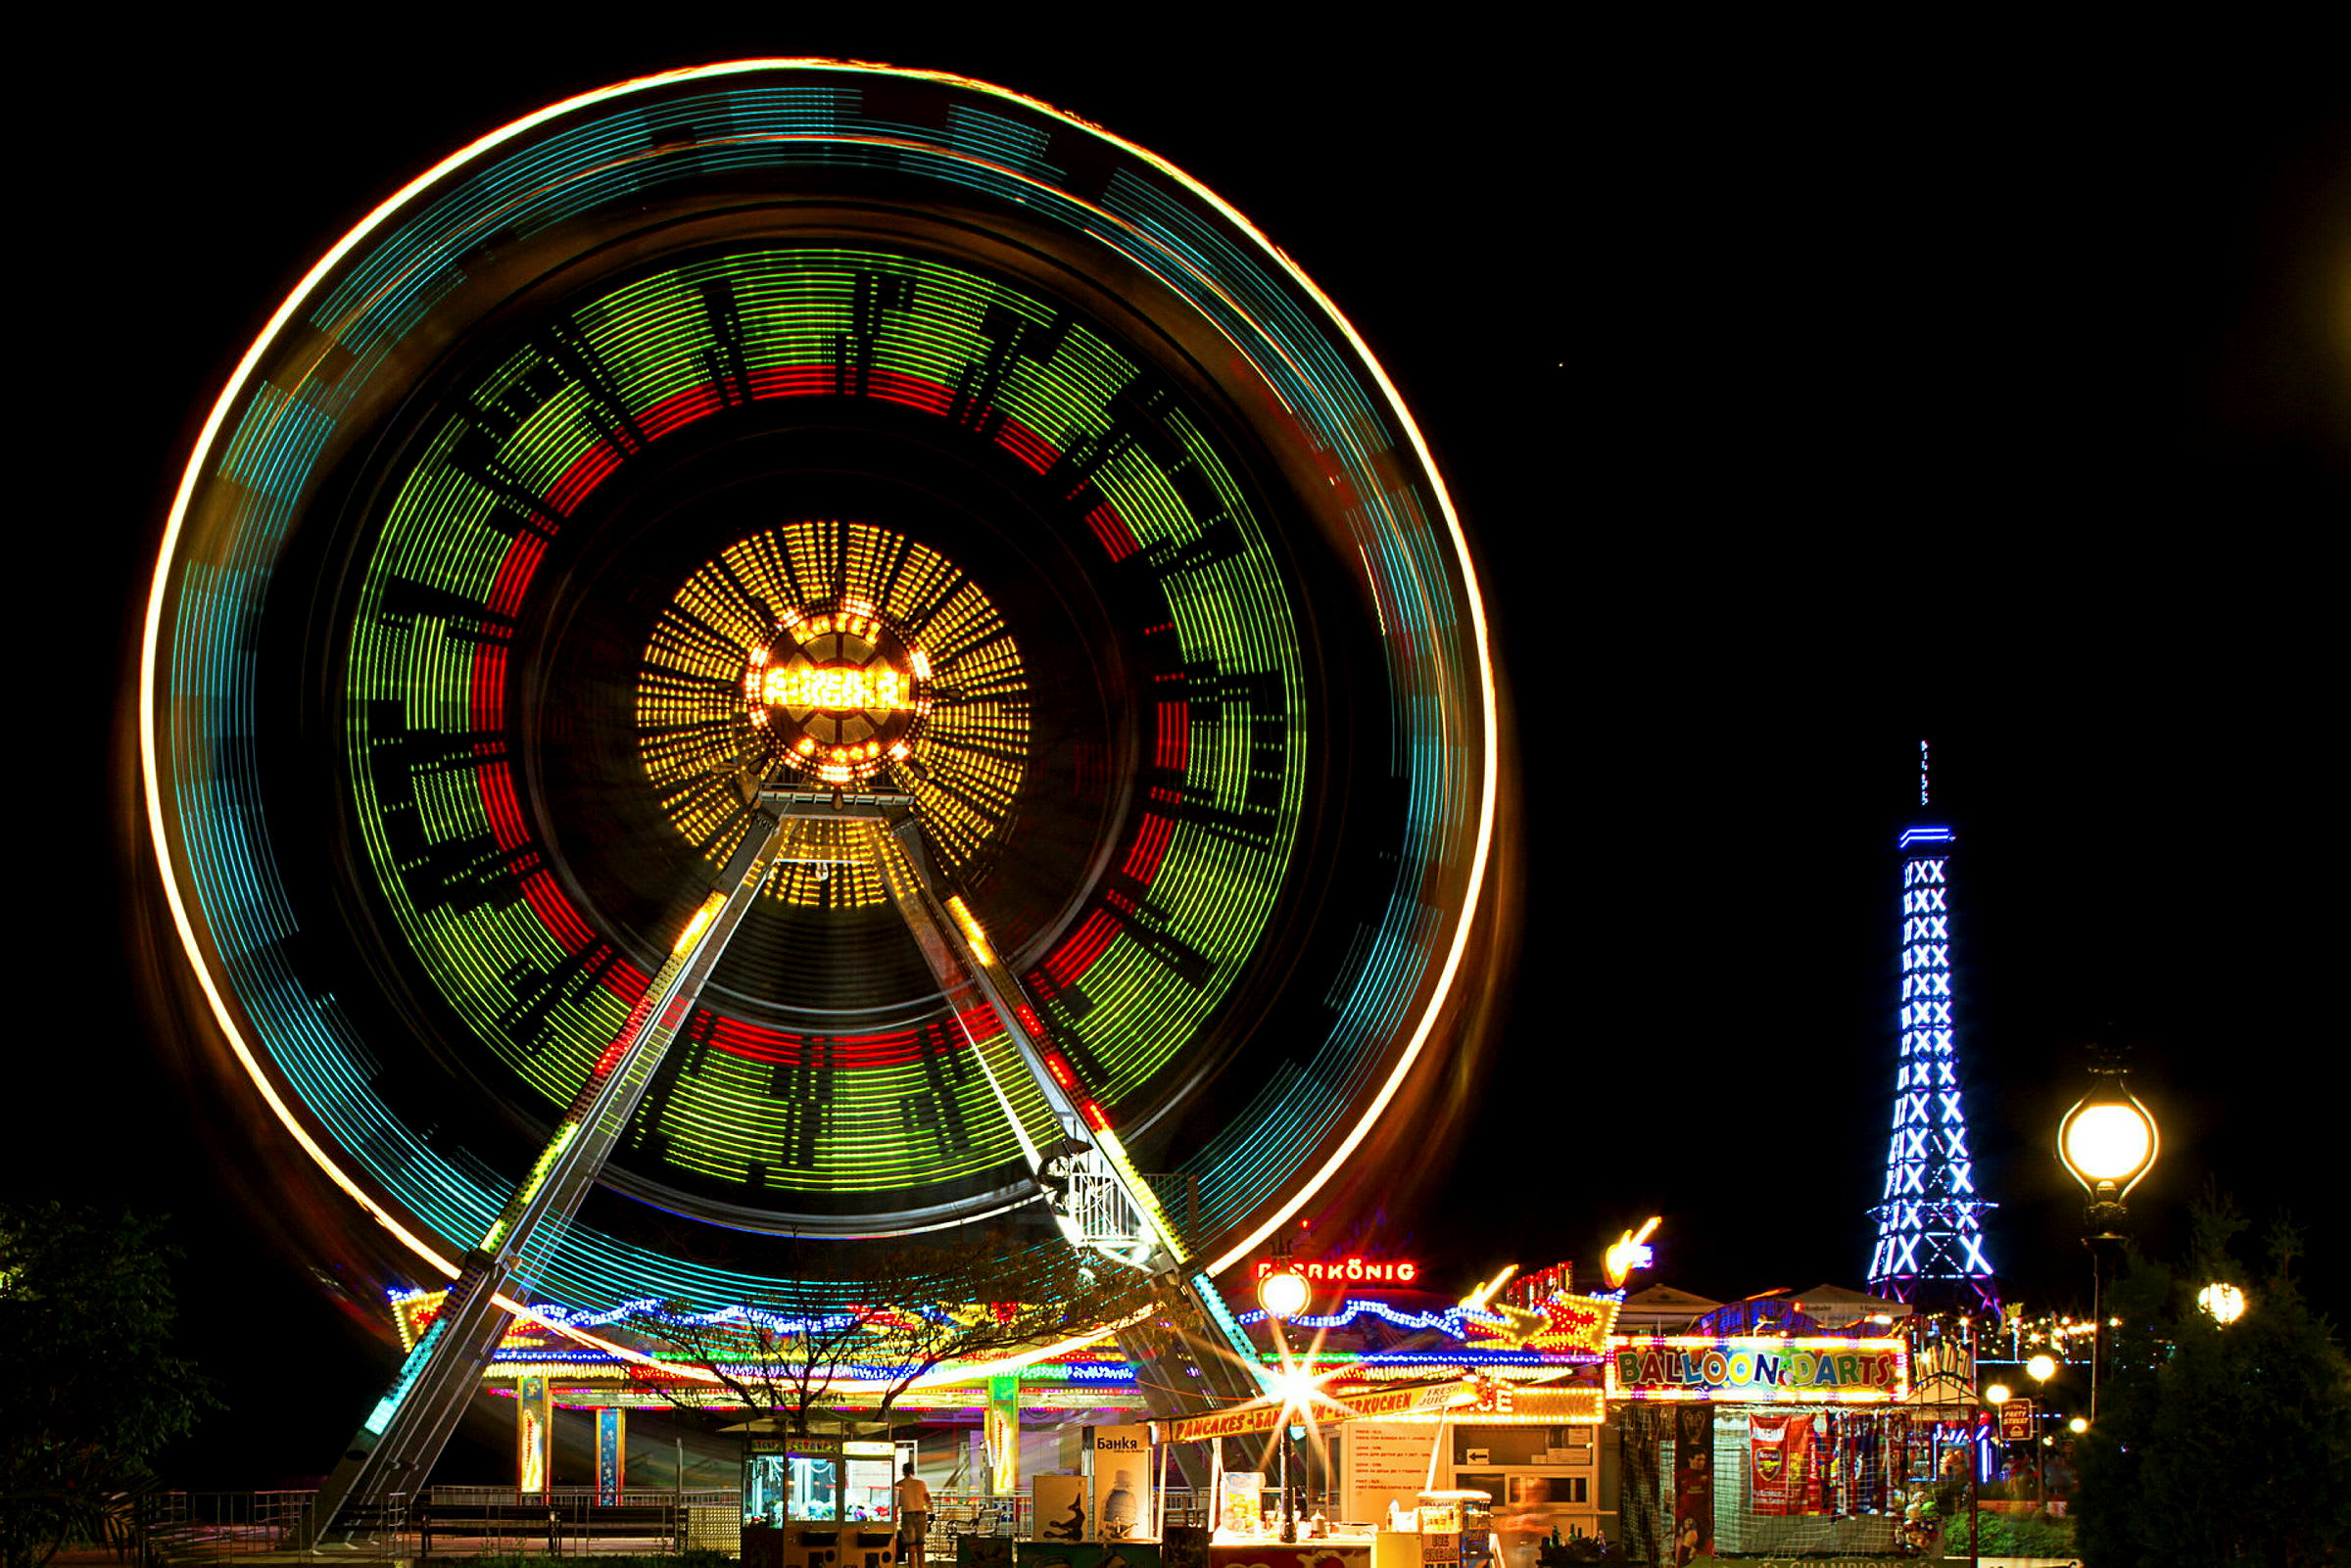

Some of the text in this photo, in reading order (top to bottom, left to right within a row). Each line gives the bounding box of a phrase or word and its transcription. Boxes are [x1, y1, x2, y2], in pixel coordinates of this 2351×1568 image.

[1616, 1353, 1891, 1387] BALLOON DARTS
[1176, 1413, 1246, 1440] PANCAKES
[1097, 1436, 1137, 1449] Банкя
